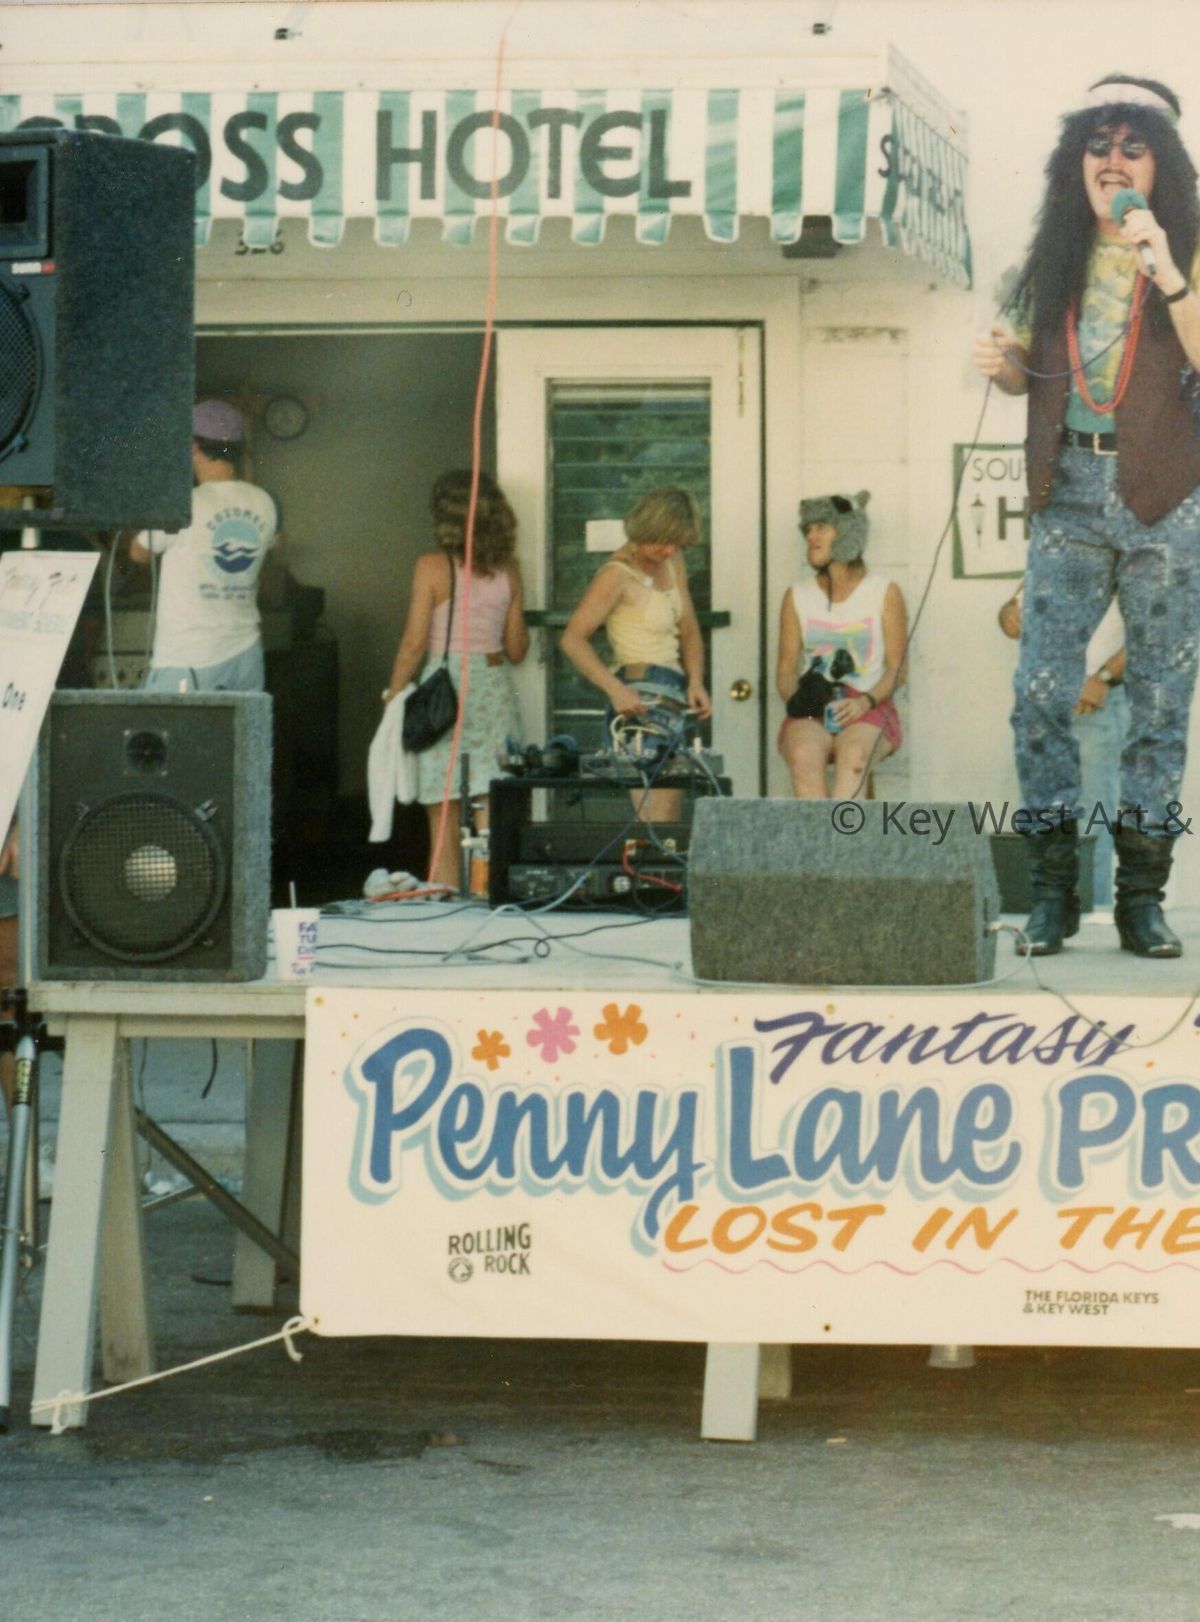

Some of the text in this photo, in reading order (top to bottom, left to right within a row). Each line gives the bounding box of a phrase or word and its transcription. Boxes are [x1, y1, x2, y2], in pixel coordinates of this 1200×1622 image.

[375, 107, 691, 201] HOTEL
[754, 1011, 1137, 1085] Fantasy
[361, 1027, 706, 1240] Penny
[729, 1045, 1022, 1190] Lane
[448, 1221, 532, 1256] ROLLING
[664, 1202, 887, 1254] LOST
[911, 1206, 1020, 1253] IN
[484, 1251, 531, 1276] ROCK
[1022, 1302, 1110, 1315] & KEY WEST
[1024, 1290, 1160, 1304] THE FLORIDA KEYS
